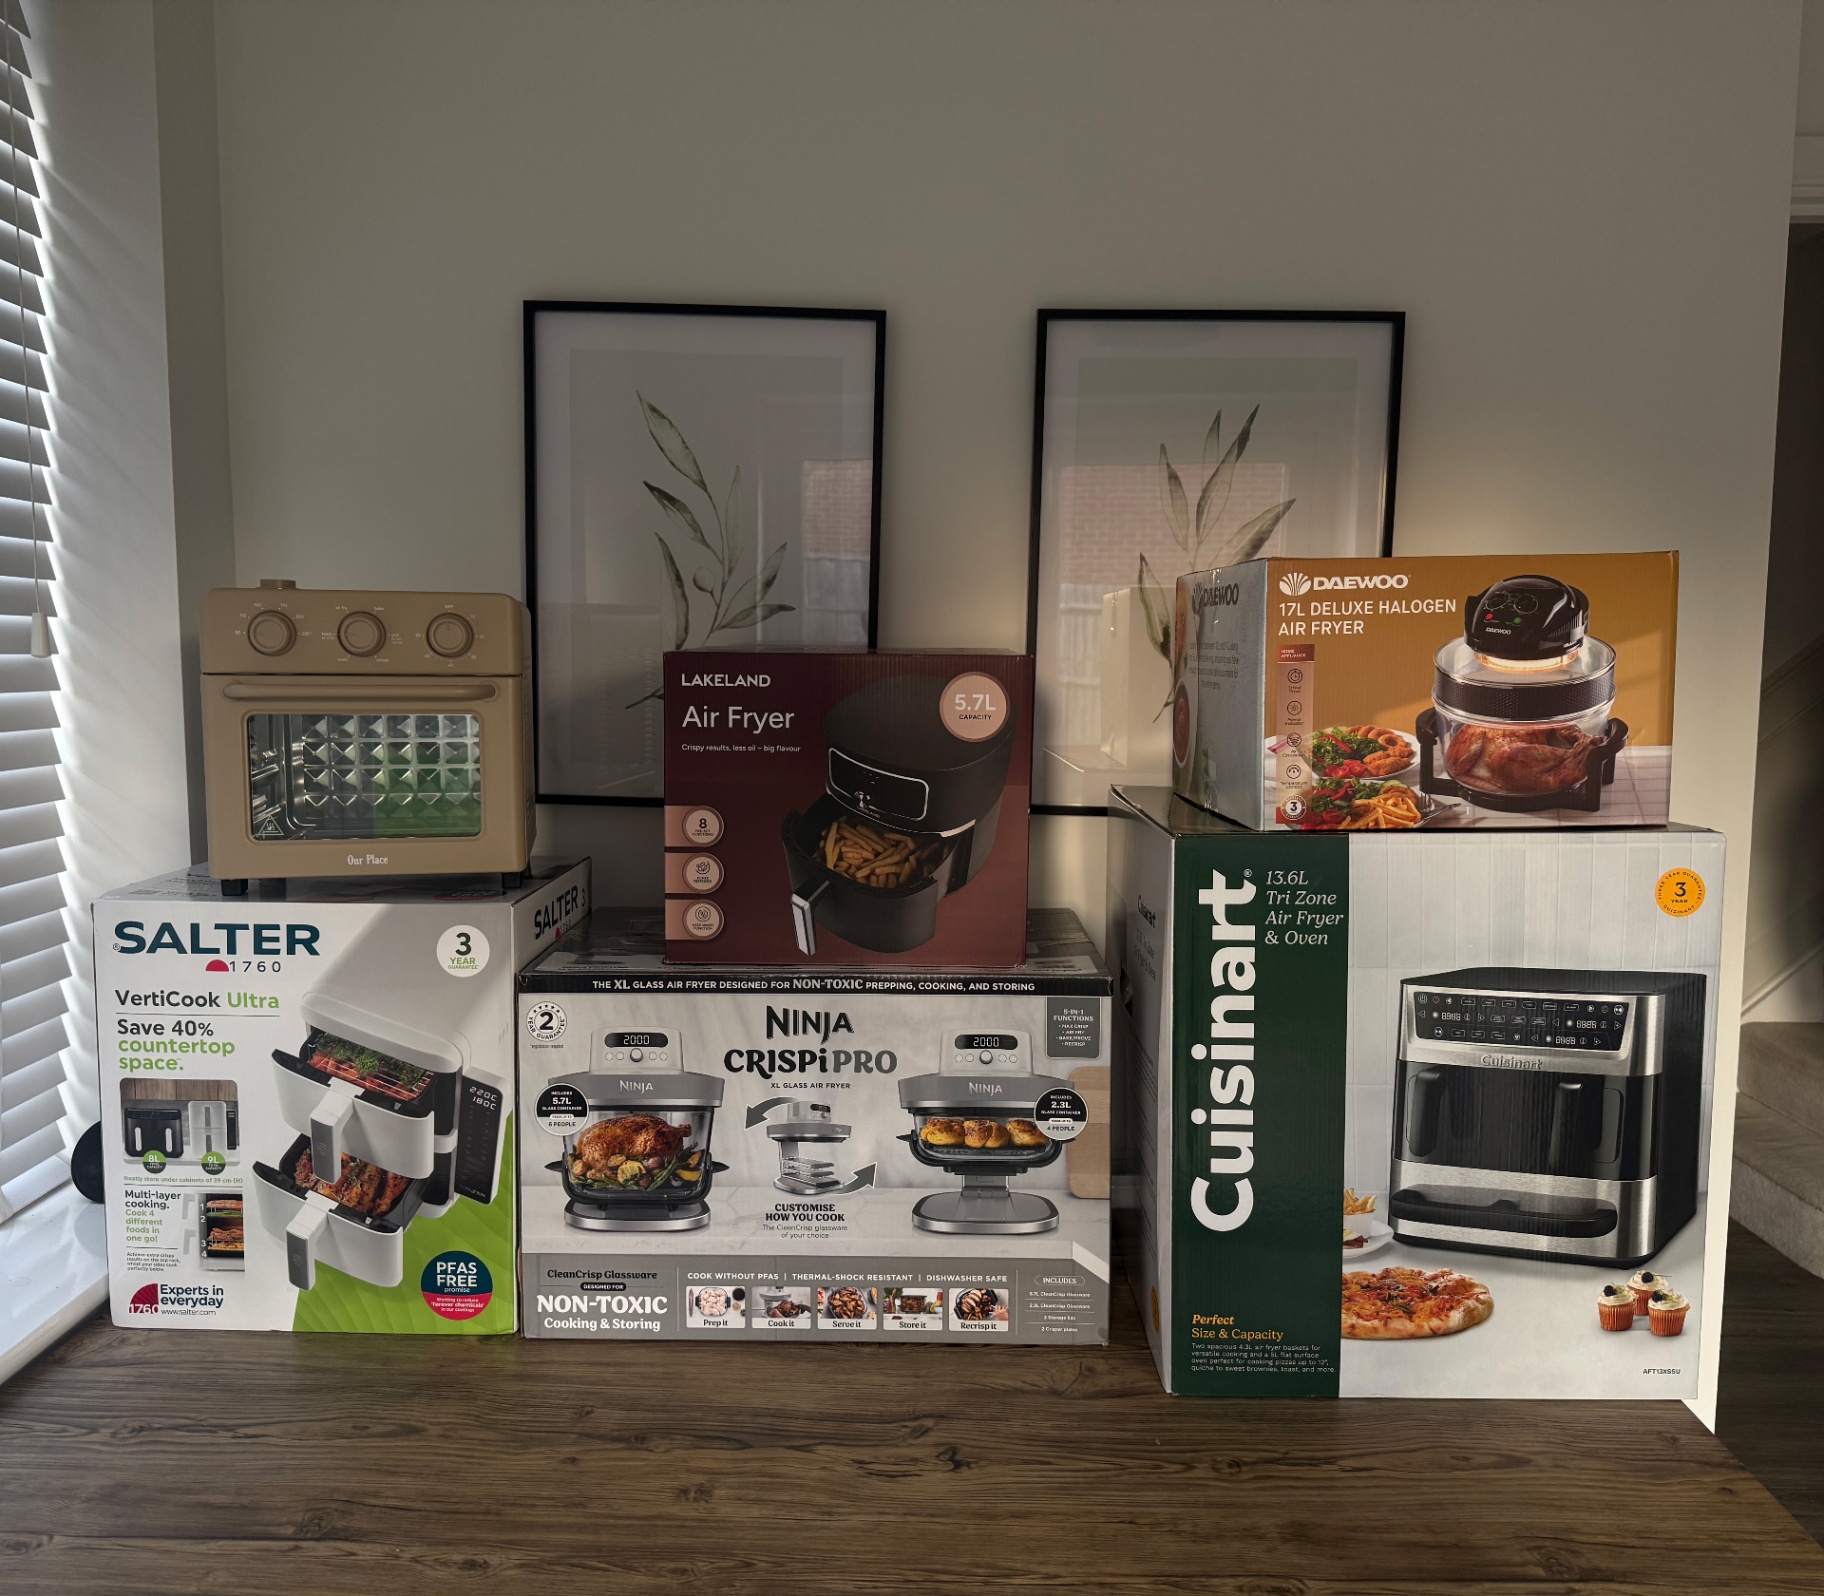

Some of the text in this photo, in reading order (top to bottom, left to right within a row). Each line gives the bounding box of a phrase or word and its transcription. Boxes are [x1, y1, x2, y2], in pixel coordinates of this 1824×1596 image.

[1313, 574, 1409, 590] DAEWOO
[1202, 583, 1239, 607] DAEWOO
[1279, 599, 1456, 617] 17L DELUXE HALOGEN
[1278, 620, 1364, 636] AIR FRYER
[681, 673, 771, 688] LAKELAND
[954, 693, 997, 712] 5.7L
[681, 705, 795, 734] Air Fryer
[958, 713, 992, 721] CAPACITY
[681, 743, 801, 754] Crispy results, less oil big flavour
[1289, 801, 1298, 812] 3
[699, 818, 707, 829] 8
[347, 855, 388, 866] Our Place
[1265, 870, 1309, 885] 13.6L
[1674, 882, 1687, 897] 3
[1266, 890, 1337, 905] Tri Zone
[534, 885, 578, 941] SALTER
[1265, 910, 1344, 929] Air Fryer
[114, 920, 321, 956] SALTER
[455, 932, 472, 956] 3
[1265, 931, 1328, 946] & Oven
[228, 960, 282, 973] 1760
[449, 956, 476, 966] YEAR
[592, 979, 1035, 992] THE XL GLASS AIR FRYER DESIGNED FOR NON-TOXIC PREPPING, COOKING, AND STORING
[115, 989, 280, 1009] VertiCook Ultra
[528, 1017, 537, 1033] YEAR
[539, 1011, 554, 1030] 2
[766, 1005, 854, 1045] NINJA
[117, 1019, 214, 1037] Save 40%
[623, 1034, 650, 1045] 2000
[973, 1036, 1000, 1047] 2000
[118, 1039, 236, 1057] countertop
[1190, 868, 1257, 1232] Cuisinart
[119, 1056, 184, 1072] space.
[1480, 1054, 1544, 1070] Cuisinart
[619, 1079, 654, 1095] NINJA
[968, 1081, 1003, 1097] NINJA
[552, 1097, 572, 1105] 5.7L
[1051, 1101, 1072, 1109] 2.3L
[148, 1154, 161, 1163] 8L
[207, 1156, 220, 1164] 9L
[125, 1190, 182, 1201] Multi-layer
[125, 1200, 170, 1210] cooking.
[774, 1203, 836, 1213] CUSTOMISE
[125, 1209, 147, 1217] Cook
[200, 1215, 206, 1223] 2
[765, 1212, 846, 1223] HOW YOU COOK
[125, 1217, 163, 1226] different
[126, 1226, 150, 1234] foods
[776, 1224, 812, 1233] CleanCrisp
[143, 1235, 158, 1244] go!
[436, 1262, 477, 1274] PFAS
[436, 1275, 478, 1287] FREE
[547, 1269, 658, 1281] CleanCrisp Glassware
[687, 1272, 712, 1280] COOK
[714, 1272, 756, 1280] WITHOUT
[792, 1273, 913, 1282] THERMAL-SHOCK RESISTANT
[926, 1274, 983, 1282] DISHWASHER
[160, 1284, 224, 1297] Experts in
[160, 1296, 224, 1308] everyday
[536, 1294, 668, 1315] NON-TOXIC
[127, 1303, 159, 1315] 1760
[544, 1317, 661, 1332] Cooking & Storing
[703, 1318, 728, 1328] Prep it
[768, 1319, 795, 1327] Cook it
[832, 1320, 861, 1328] Serve it
[899, 1320, 927, 1329] Store it
[1192, 1314, 1235, 1325] Perfect
[960, 1321, 997, 1331] Recrisp it
[1191, 1327, 1284, 1342] Size & Capacity
[1265, 1344, 1282, 1352] fryer
